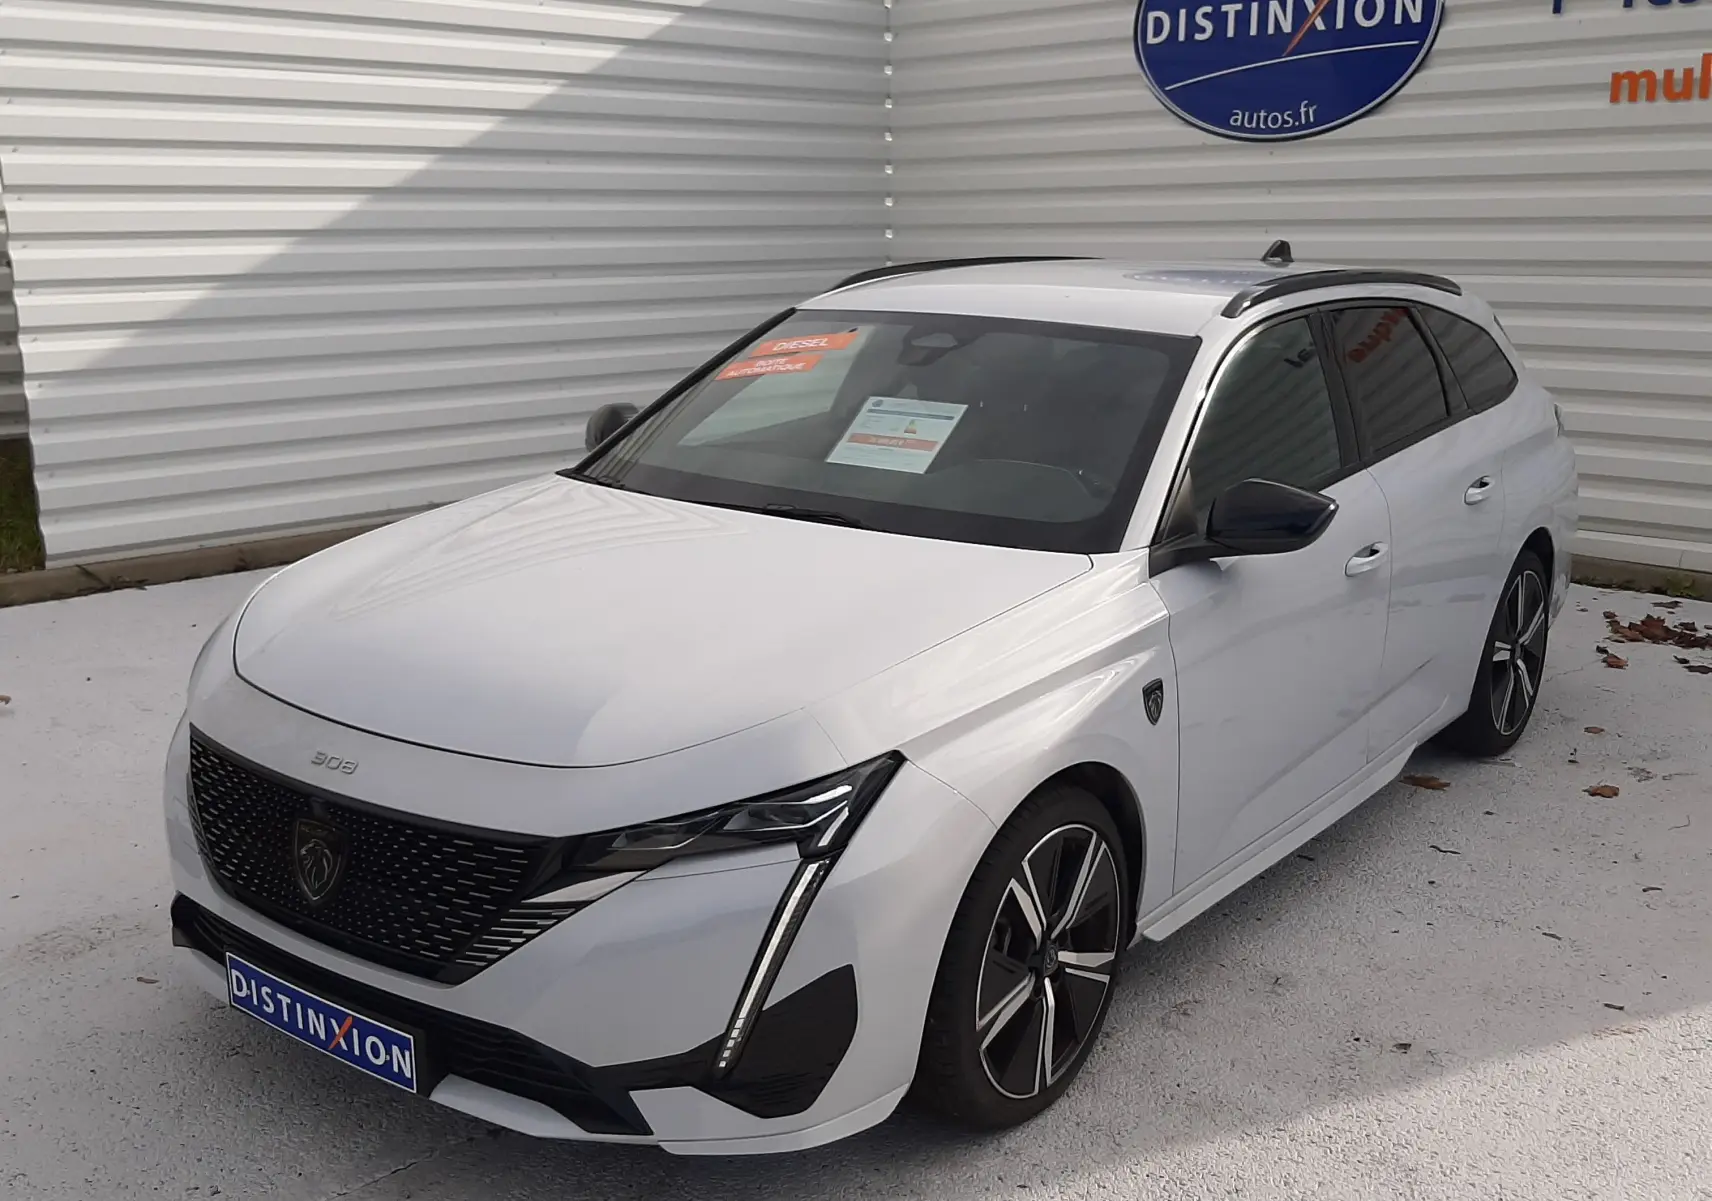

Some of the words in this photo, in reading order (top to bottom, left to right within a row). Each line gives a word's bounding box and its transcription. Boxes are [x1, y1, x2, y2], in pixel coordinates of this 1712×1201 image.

[1146, 0, 1424, 54] DISTINXION
[1230, 101, 1317, 129] autos.fr
[773, 338, 828, 351] DIESEL
[311, 751, 359, 774] 308
[231, 968, 411, 1078] DISTINXION
